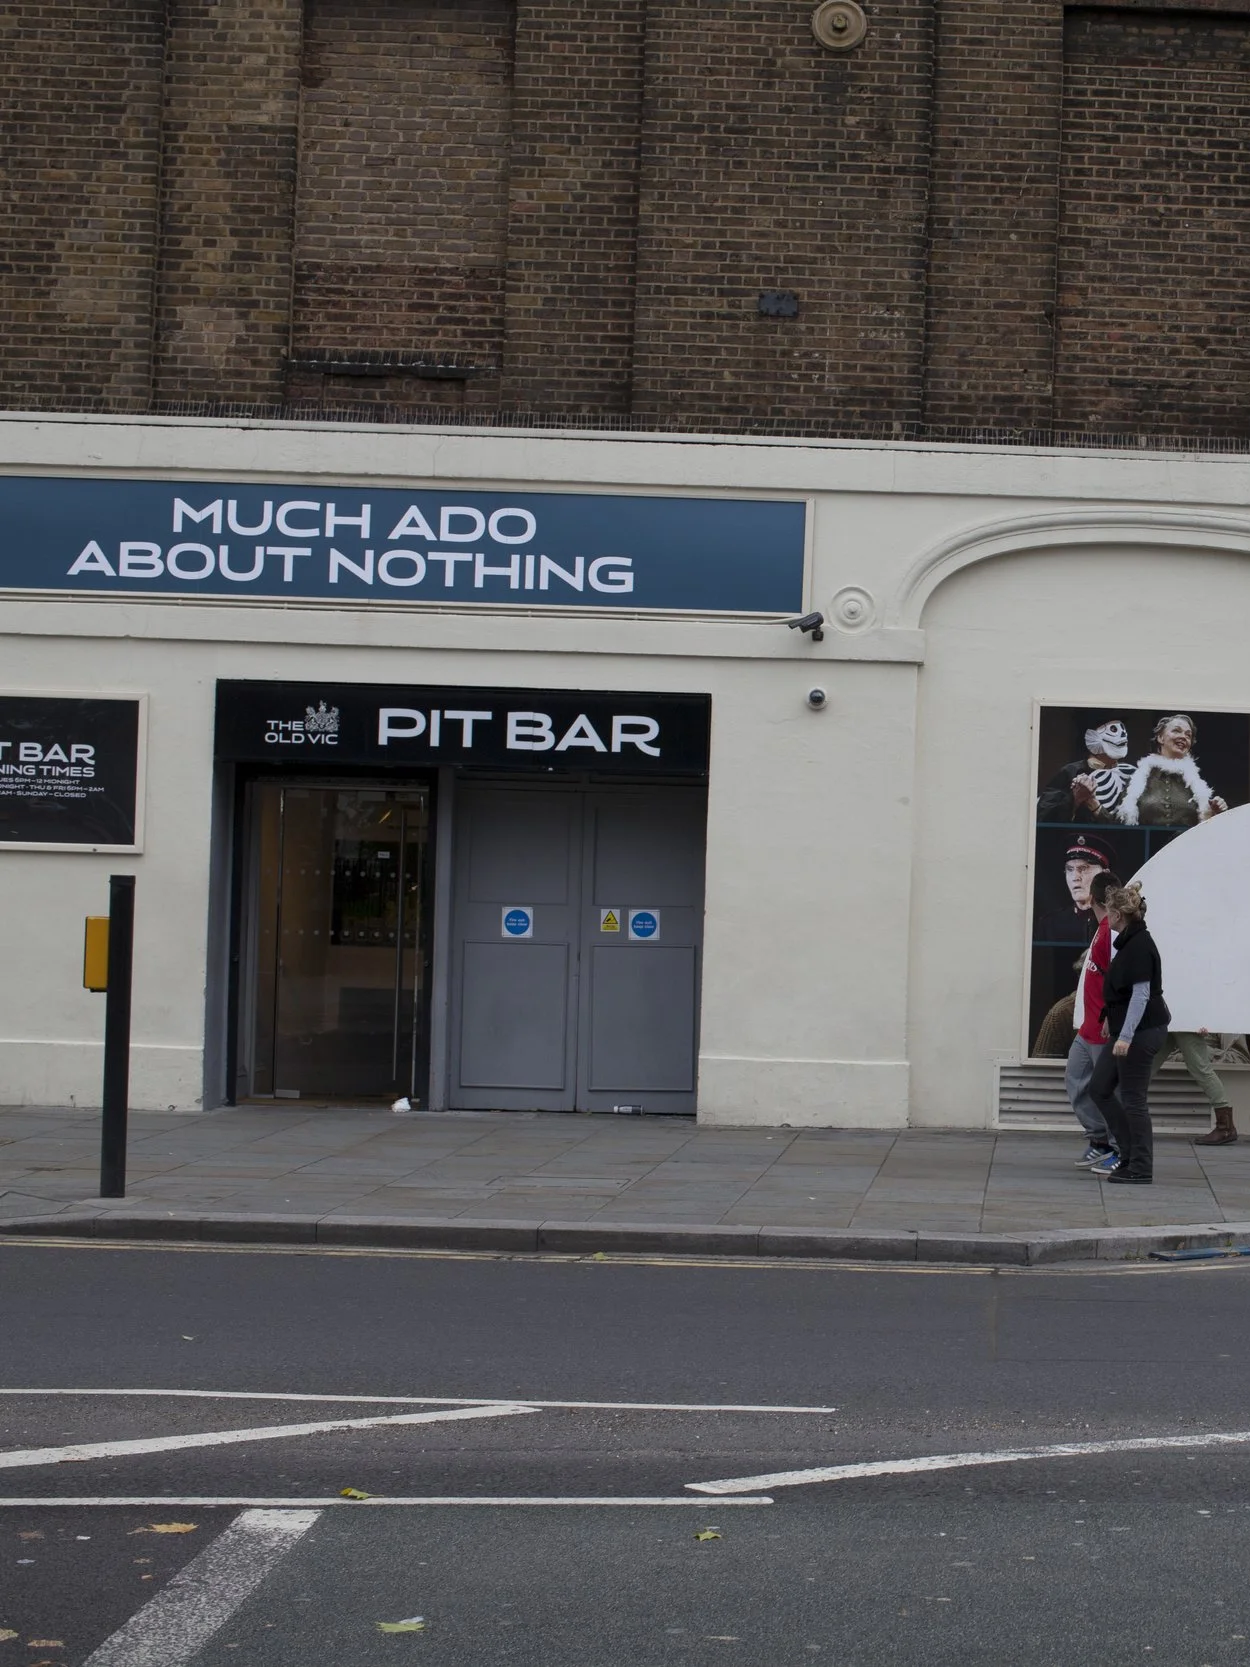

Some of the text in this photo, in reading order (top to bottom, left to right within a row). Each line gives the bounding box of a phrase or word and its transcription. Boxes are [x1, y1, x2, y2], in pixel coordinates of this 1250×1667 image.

[172, 497, 537, 545] MUCH ADO
[66, 540, 634, 594] ABOUT NOTHING
[266, 720, 304, 731] THE
[377, 708, 661, 757] PIT BAR
[264, 732, 338, 745] OLD VIC
[19, 742, 96, 766] BAR
[39, 766, 95, 778] TIMES
